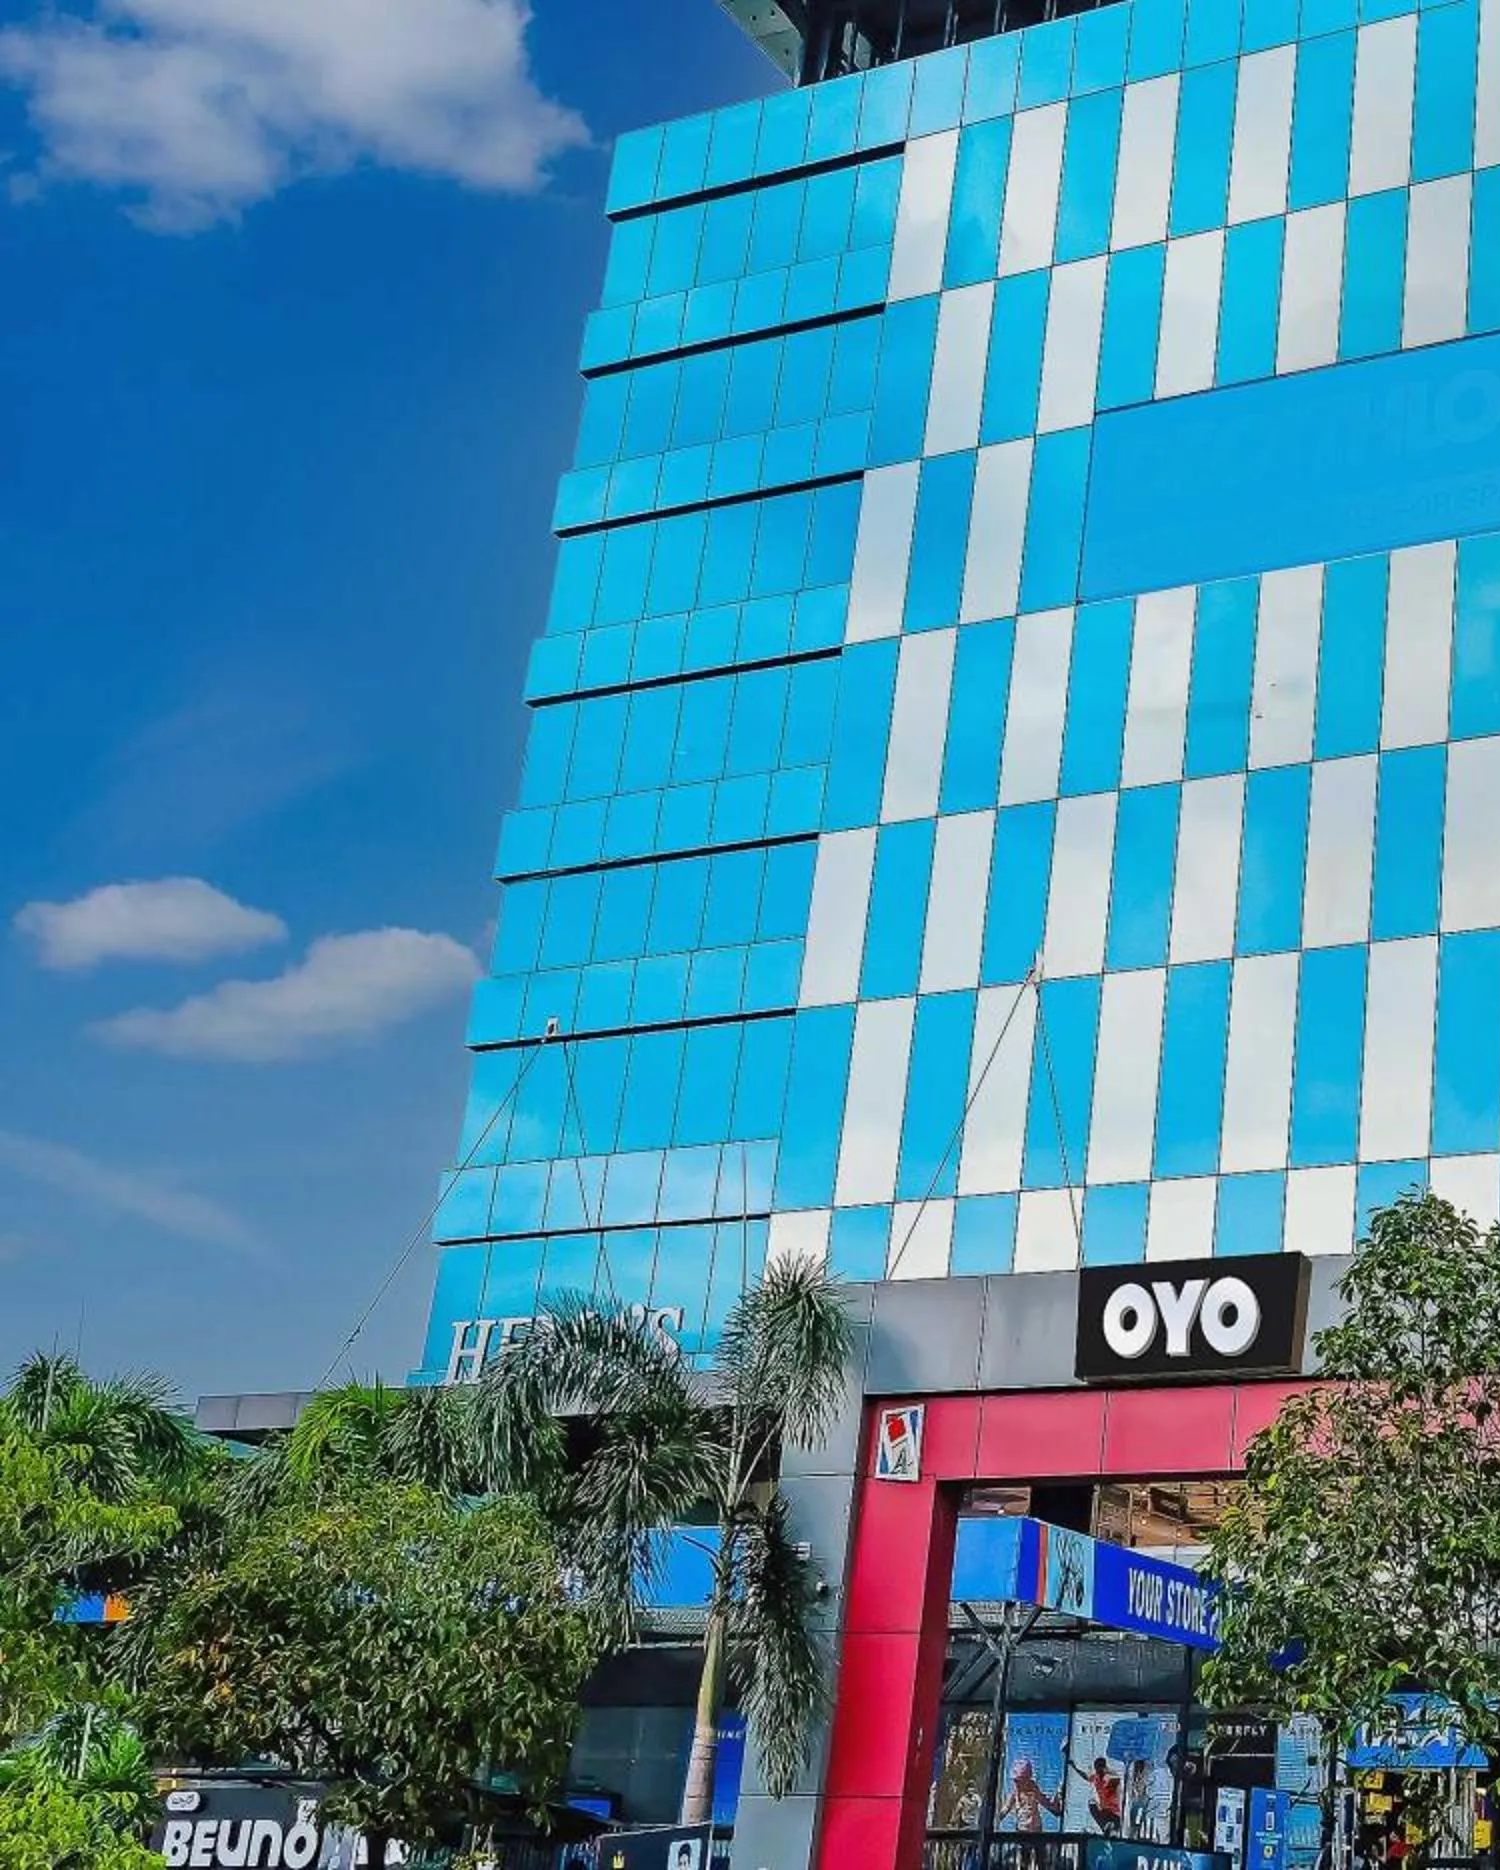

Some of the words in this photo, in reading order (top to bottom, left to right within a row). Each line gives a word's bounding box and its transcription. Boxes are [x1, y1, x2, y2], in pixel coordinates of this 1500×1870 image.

[1103, 1276, 1261, 1358] OYO
[1128, 1568, 1161, 1623] YOUR
[1166, 1580, 1208, 1635] STORE
